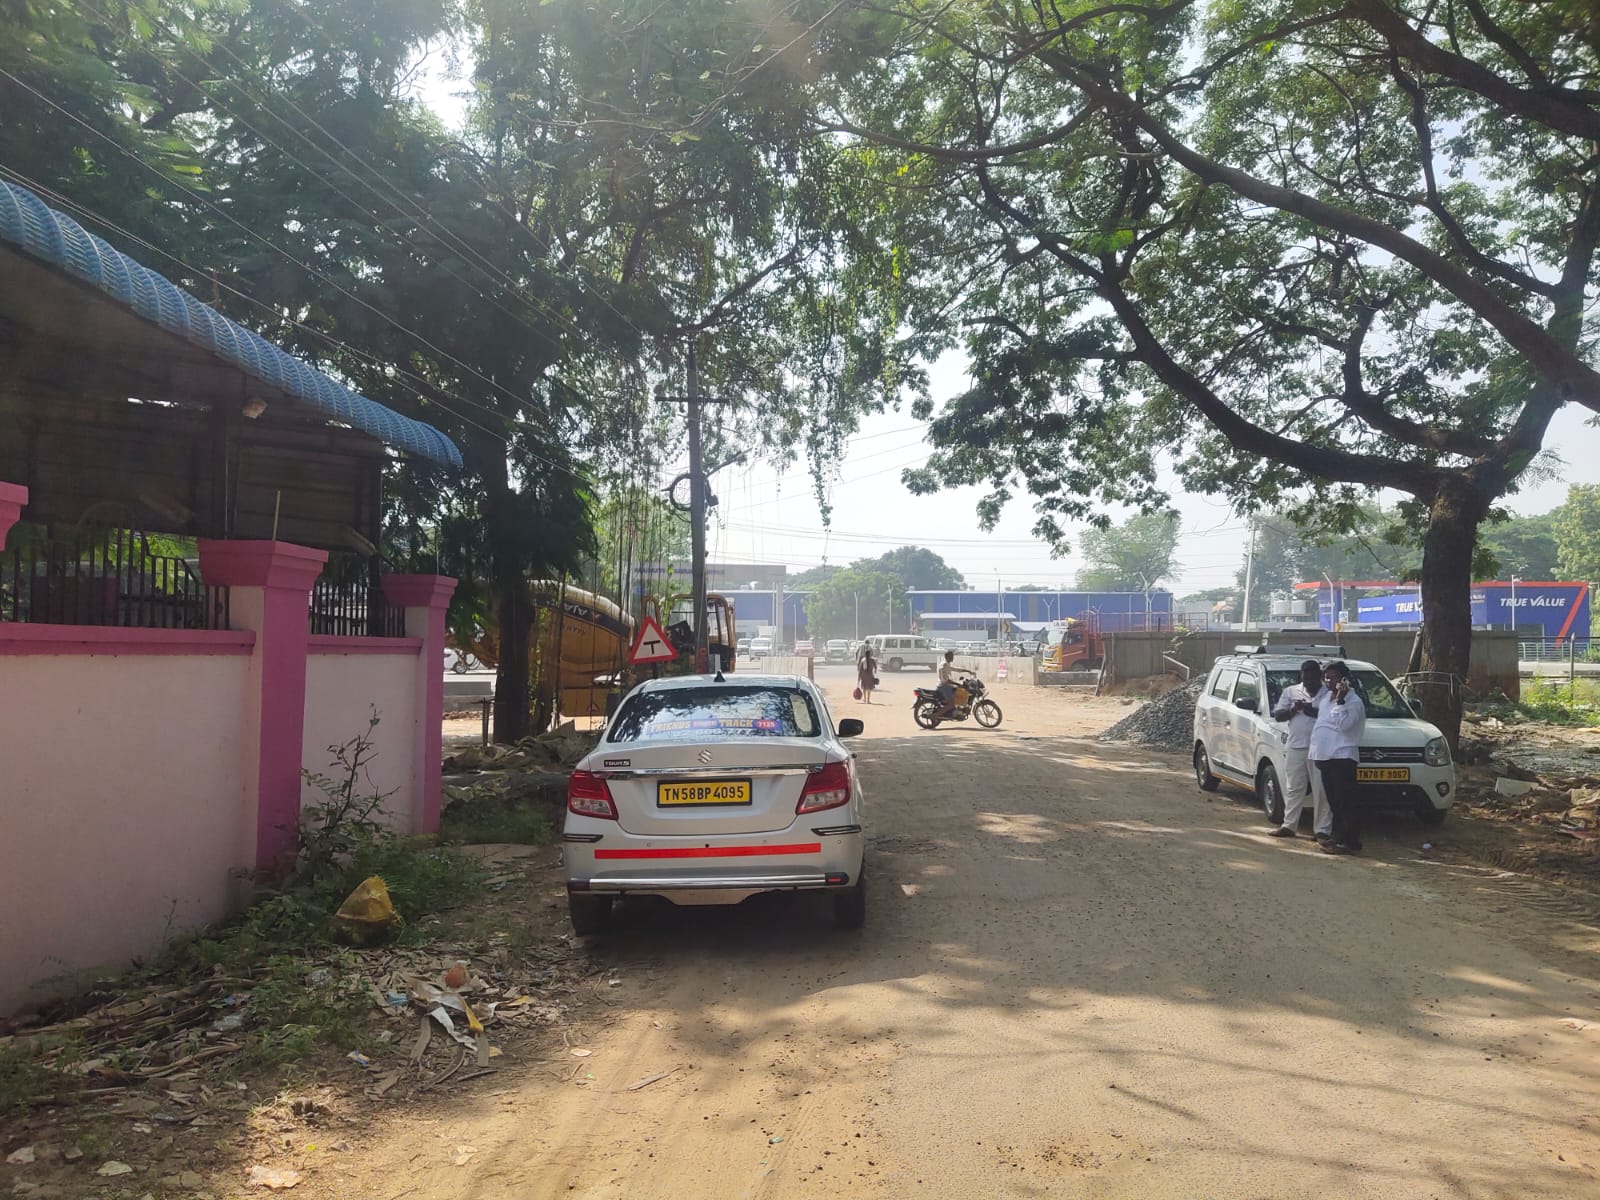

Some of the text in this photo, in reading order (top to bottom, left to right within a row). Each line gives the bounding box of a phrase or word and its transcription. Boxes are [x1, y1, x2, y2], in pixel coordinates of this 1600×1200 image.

[1500, 594, 1566, 607] TRUE VALUE
[1396, 602, 1414, 613] TRUE
